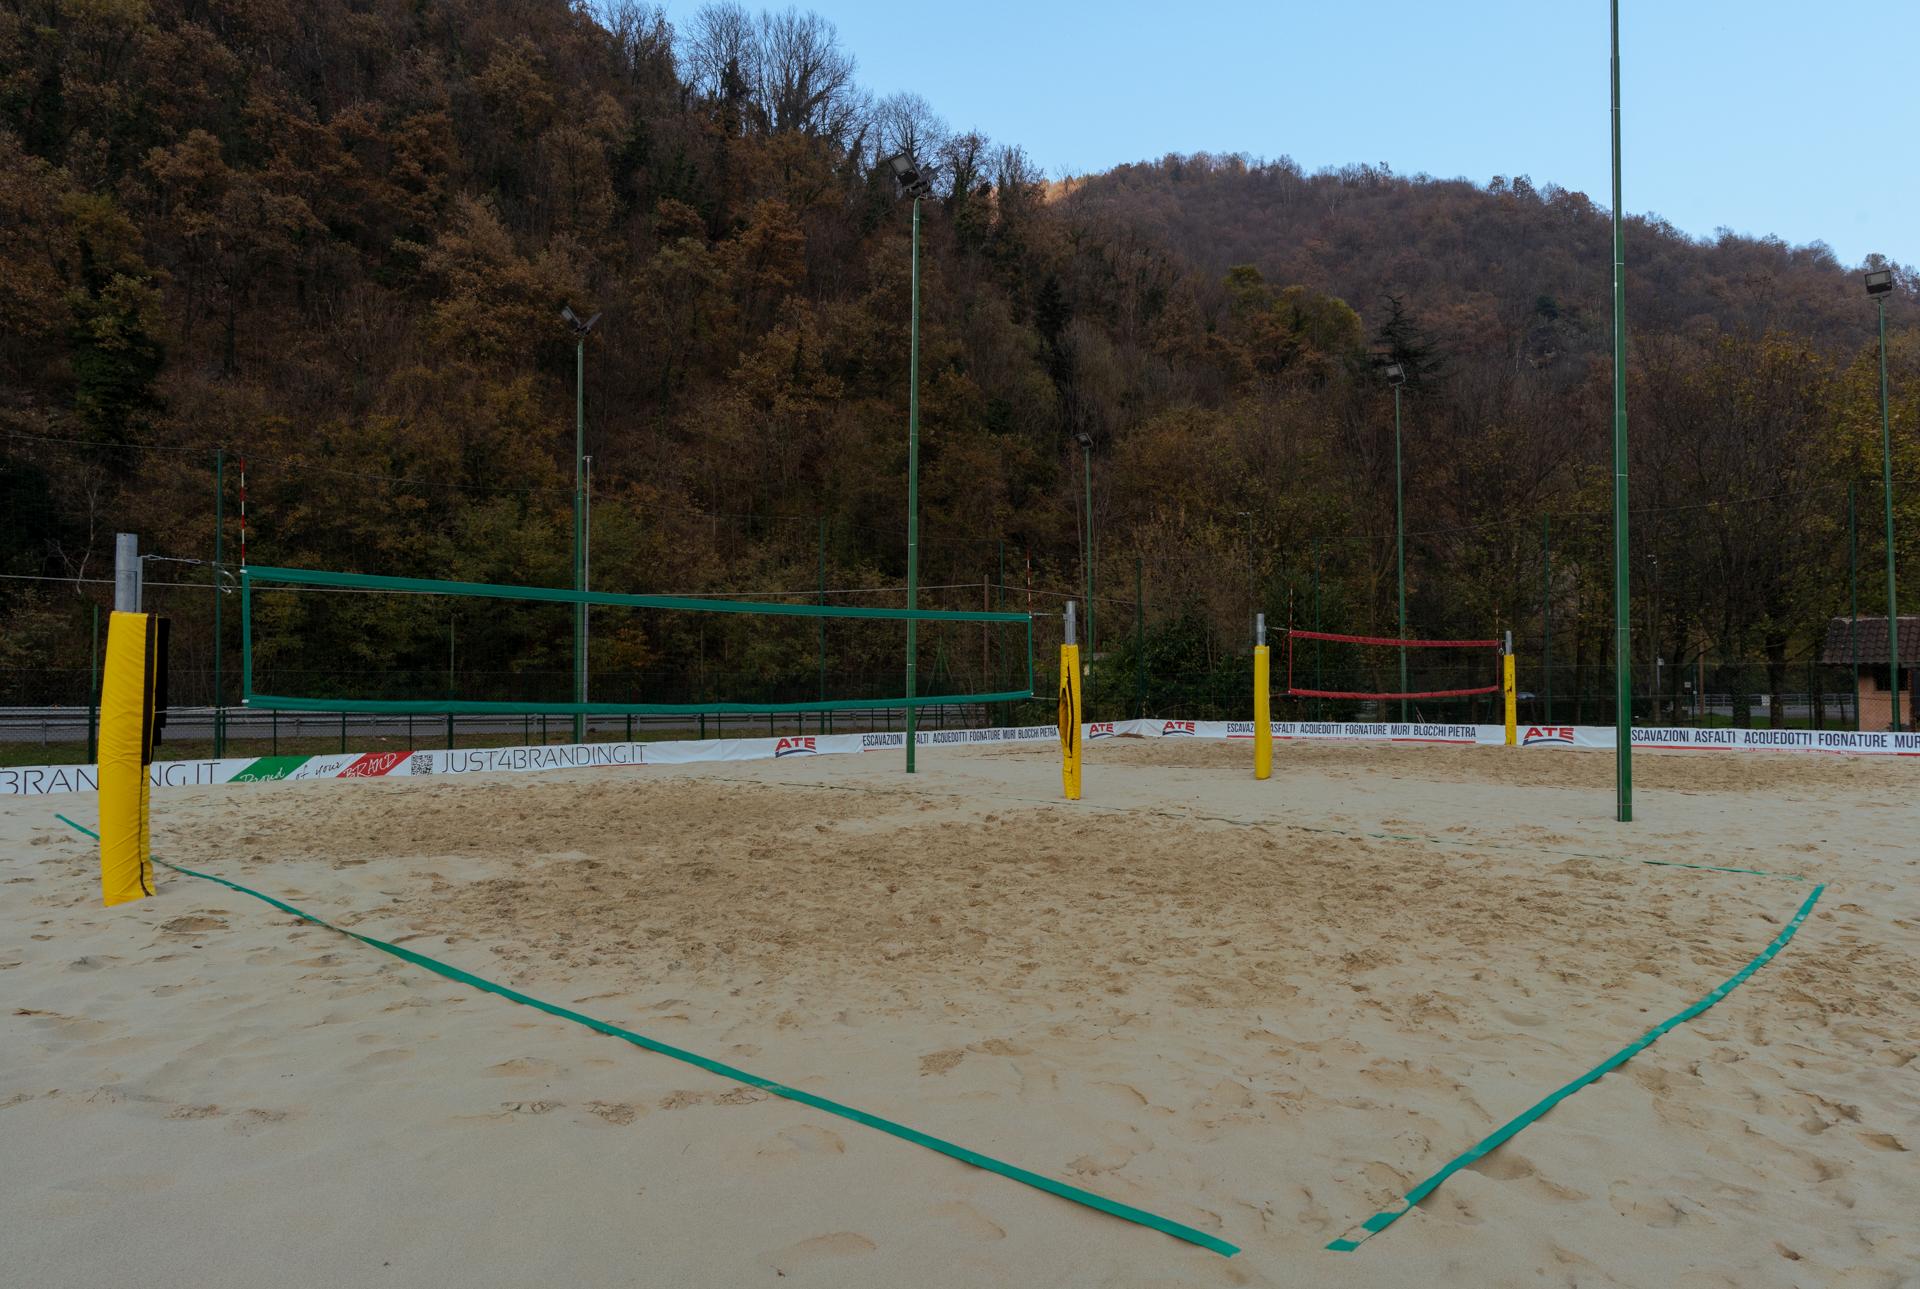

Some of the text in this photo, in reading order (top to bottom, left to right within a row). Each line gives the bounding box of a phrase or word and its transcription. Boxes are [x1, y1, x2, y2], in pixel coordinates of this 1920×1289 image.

[1089, 723, 1114, 734] ATE
[1163, 721, 1195, 731] ATE
[1300, 724, 1342, 735] ACQUEDOTTI
[1345, 724, 1387, 735] FOGNATURE
[1390, 725, 1410, 736] MURI
[1413, 725, 1446, 737] BLOCCHI
[1448, 726, 1476, 737] PIETRA
[862, 733, 903, 746] ESCAVAZIONI
[933, 730, 967, 744] ACQUEDOTTI
[969, 729, 1001, 741] FOGNATURE
[1003, 729, 1016, 739] MURI
[1018, 727, 1039, 739] BLOCCHI
[1039, 726, 1057, 738] PIETRA
[1524, 727, 1574, 740] ATE
[1631, 729, 1689, 742] SCAVAZIONI
[1694, 730, 1736, 743] ASFALTI
[1744, 731, 1812, 746] ACQUEDOTTI
[1818, 733, 1888, 748] FOGNATURE
[775, 737, 816, 751] ATE
[343, 753, 397, 777] BRAND
[442, 745, 648, 773] JUST4BRANDING.IT
